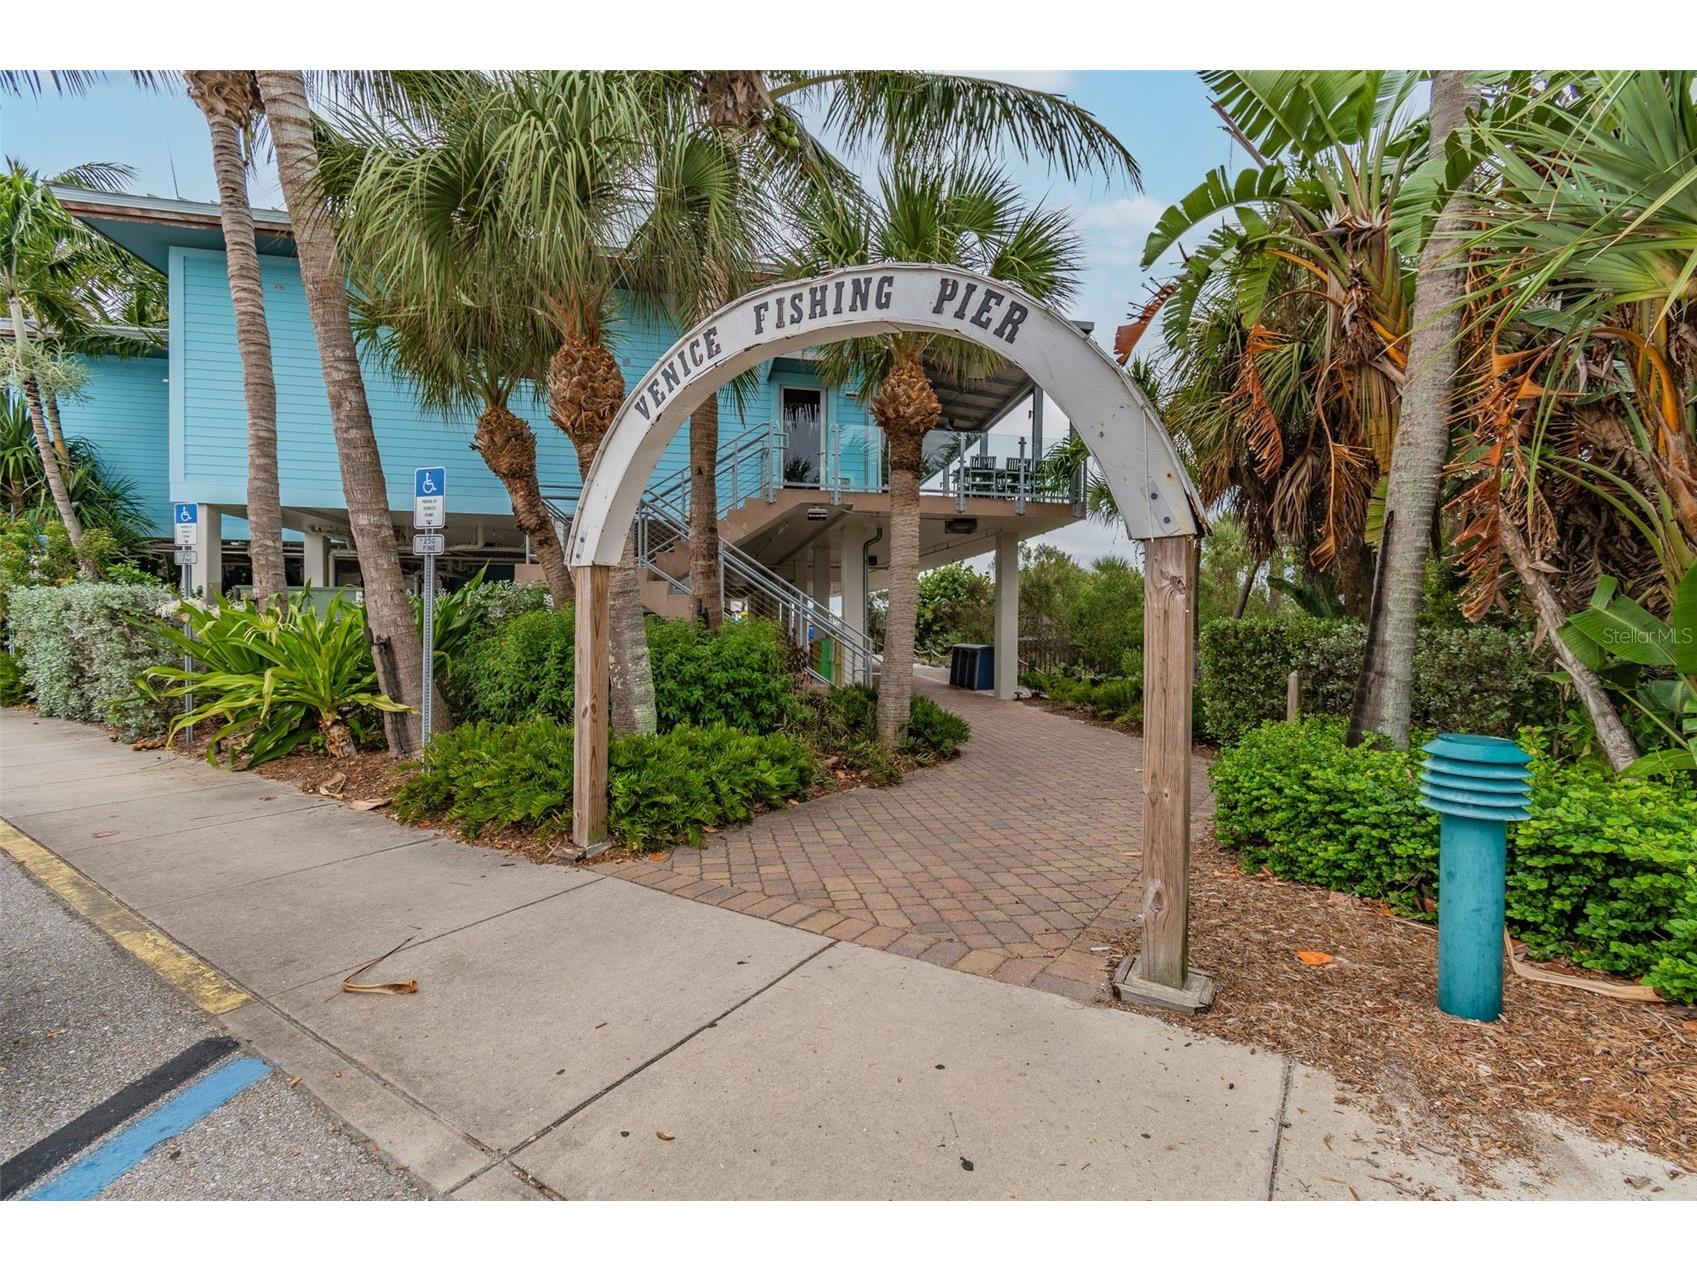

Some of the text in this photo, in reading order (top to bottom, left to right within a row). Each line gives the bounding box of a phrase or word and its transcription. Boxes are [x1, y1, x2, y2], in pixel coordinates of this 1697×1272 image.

[634, 275, 1029, 421] VENICE FISHING PIER
